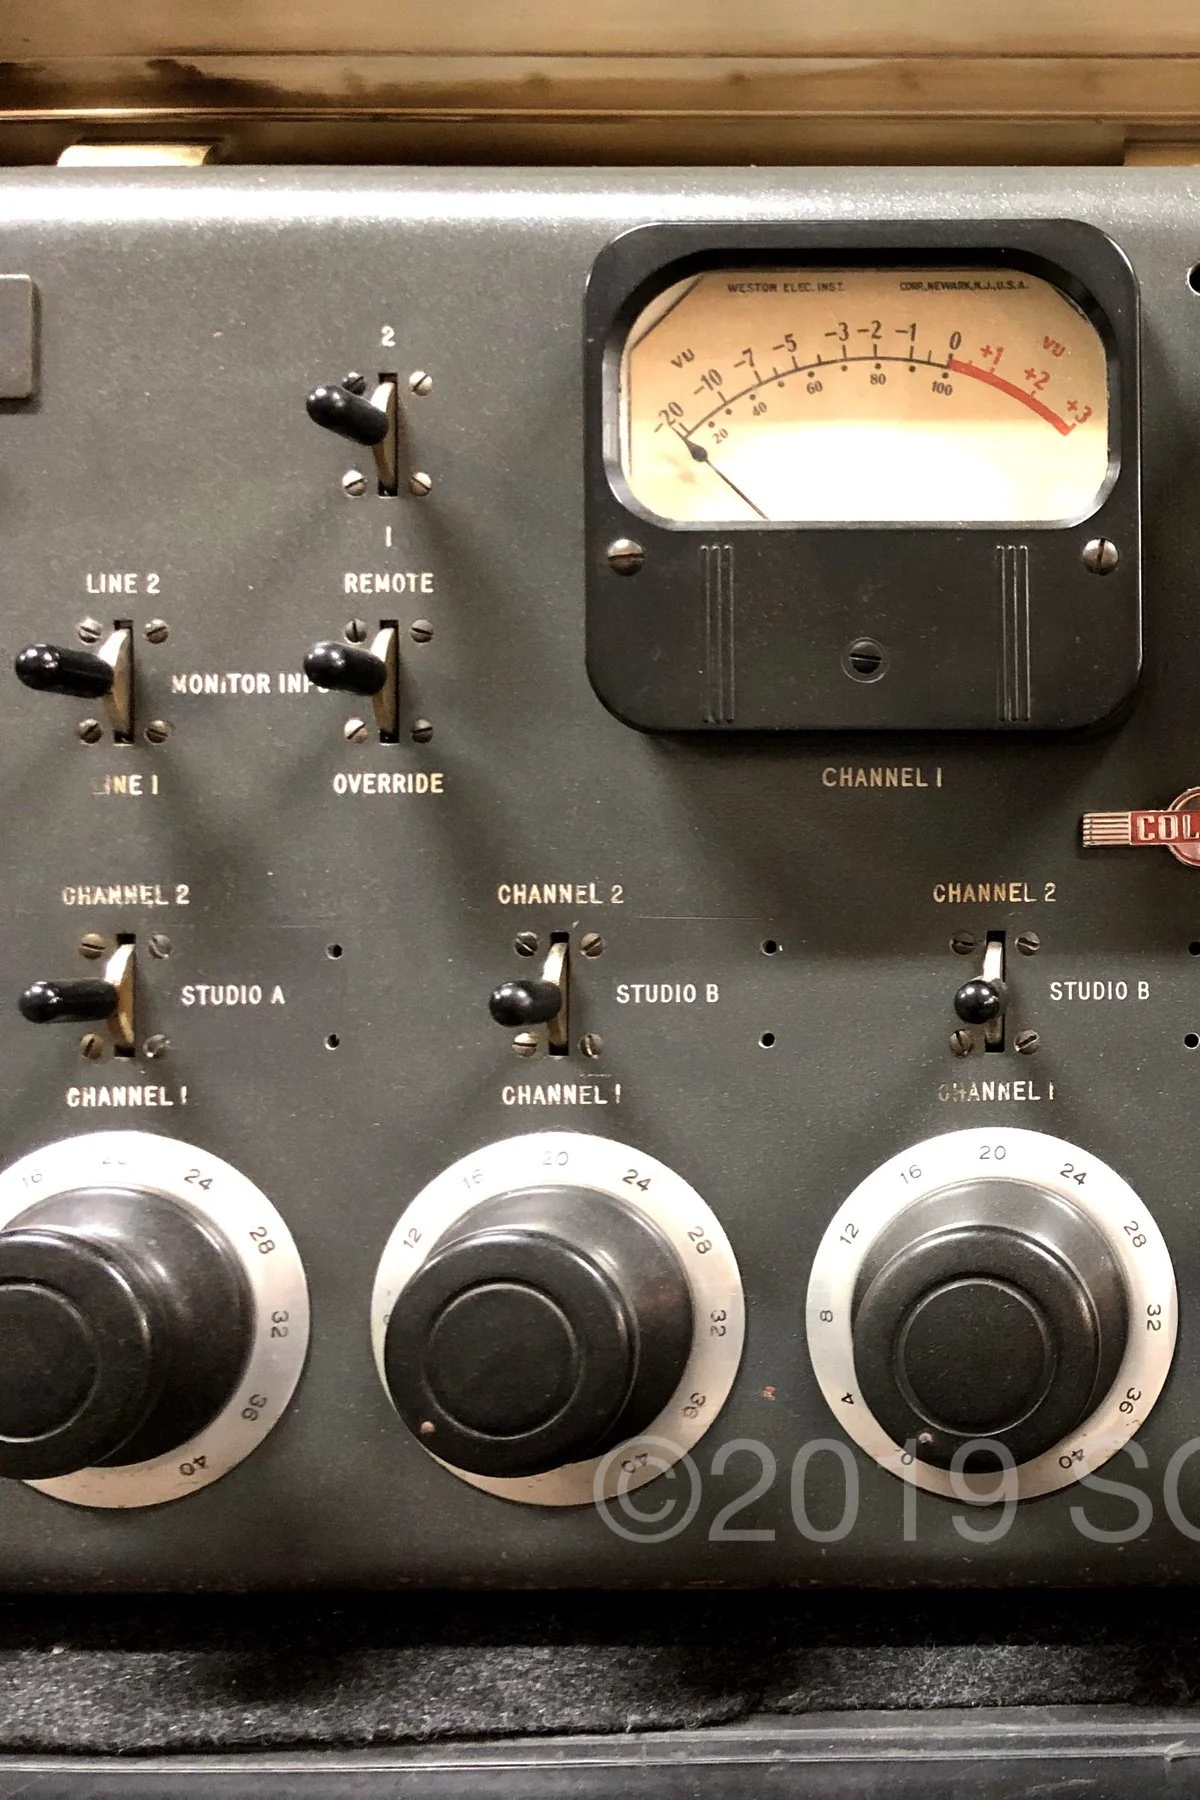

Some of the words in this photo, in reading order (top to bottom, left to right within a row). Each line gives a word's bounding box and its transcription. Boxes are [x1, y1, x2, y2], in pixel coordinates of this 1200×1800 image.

[727, 283, 778, 293] WESTON
[381, 326, 395, 347] 2
[1042, 335, 1067, 357] VU
[670, 348, 696, 370] VU
[950, 331, 963, 350] 0
[980, 343, 1003, 366] +1
[1023, 366, 1051, 391] +2
[1066, 398, 1092, 424] +3
[712, 428, 730, 446] 20
[750, 401, 769, 419] 40
[805, 381, 823, 395] 60
[870, 372, 886, 385] 80
[931, 381, 953, 397] 100
[86, 574, 138, 594] LINE
[146, 574, 160, 594] 2
[344, 573, 434, 594] REMOTE
[333, 773, 444, 794] OVERRIDE
[822, 767, 929, 788] CHANNEL
[62, 884, 169, 906] CHANNEL
[176, 884, 190, 904] 2
[498, 883, 603, 905] CHANNEL
[611, 884, 624, 904] 2
[933, 883, 1038, 902] CHANNEL
[1044, 883, 1056, 902] 2
[181, 985, 262, 1006] STUDIO
[271, 985, 285, 1004] A
[616, 984, 696, 1004] STUDIO
[707, 984, 719, 1002] B
[1050, 981, 1128, 1001] STUDIO
[1138, 981, 1150, 999] B
[66, 1086, 173, 1107] CHANNEL
[502, 1084, 608, 1105] CHANNEL
[979, 1145, 1006, 1160] 20
[184, 1168, 213, 1191] 24
[623, 1169, 651, 1192] 24
[900, 1164, 922, 1184] 16
[1060, 1163, 1088, 1186] 24
[250, 1226, 275, 1254] 28
[403, 1228, 422, 1248] 12
[688, 1226, 712, 1255] 28
[840, 1223, 859, 1245] 12
[1123, 1220, 1147, 1248] 28
[271, 1310, 289, 1339] 32
[710, 1309, 727, 1337] 32
[820, 1310, 833, 1322] 8
[1147, 1304, 1162, 1332] 32
[241, 1394, 267, 1421] 36
[682, 1392, 706, 1420] 36
[840, 1392, 855, 1405] 4
[1119, 1387, 1141, 1415] 36
[179, 1454, 207, 1476] 40
[1059, 1448, 1084, 1469] 40
